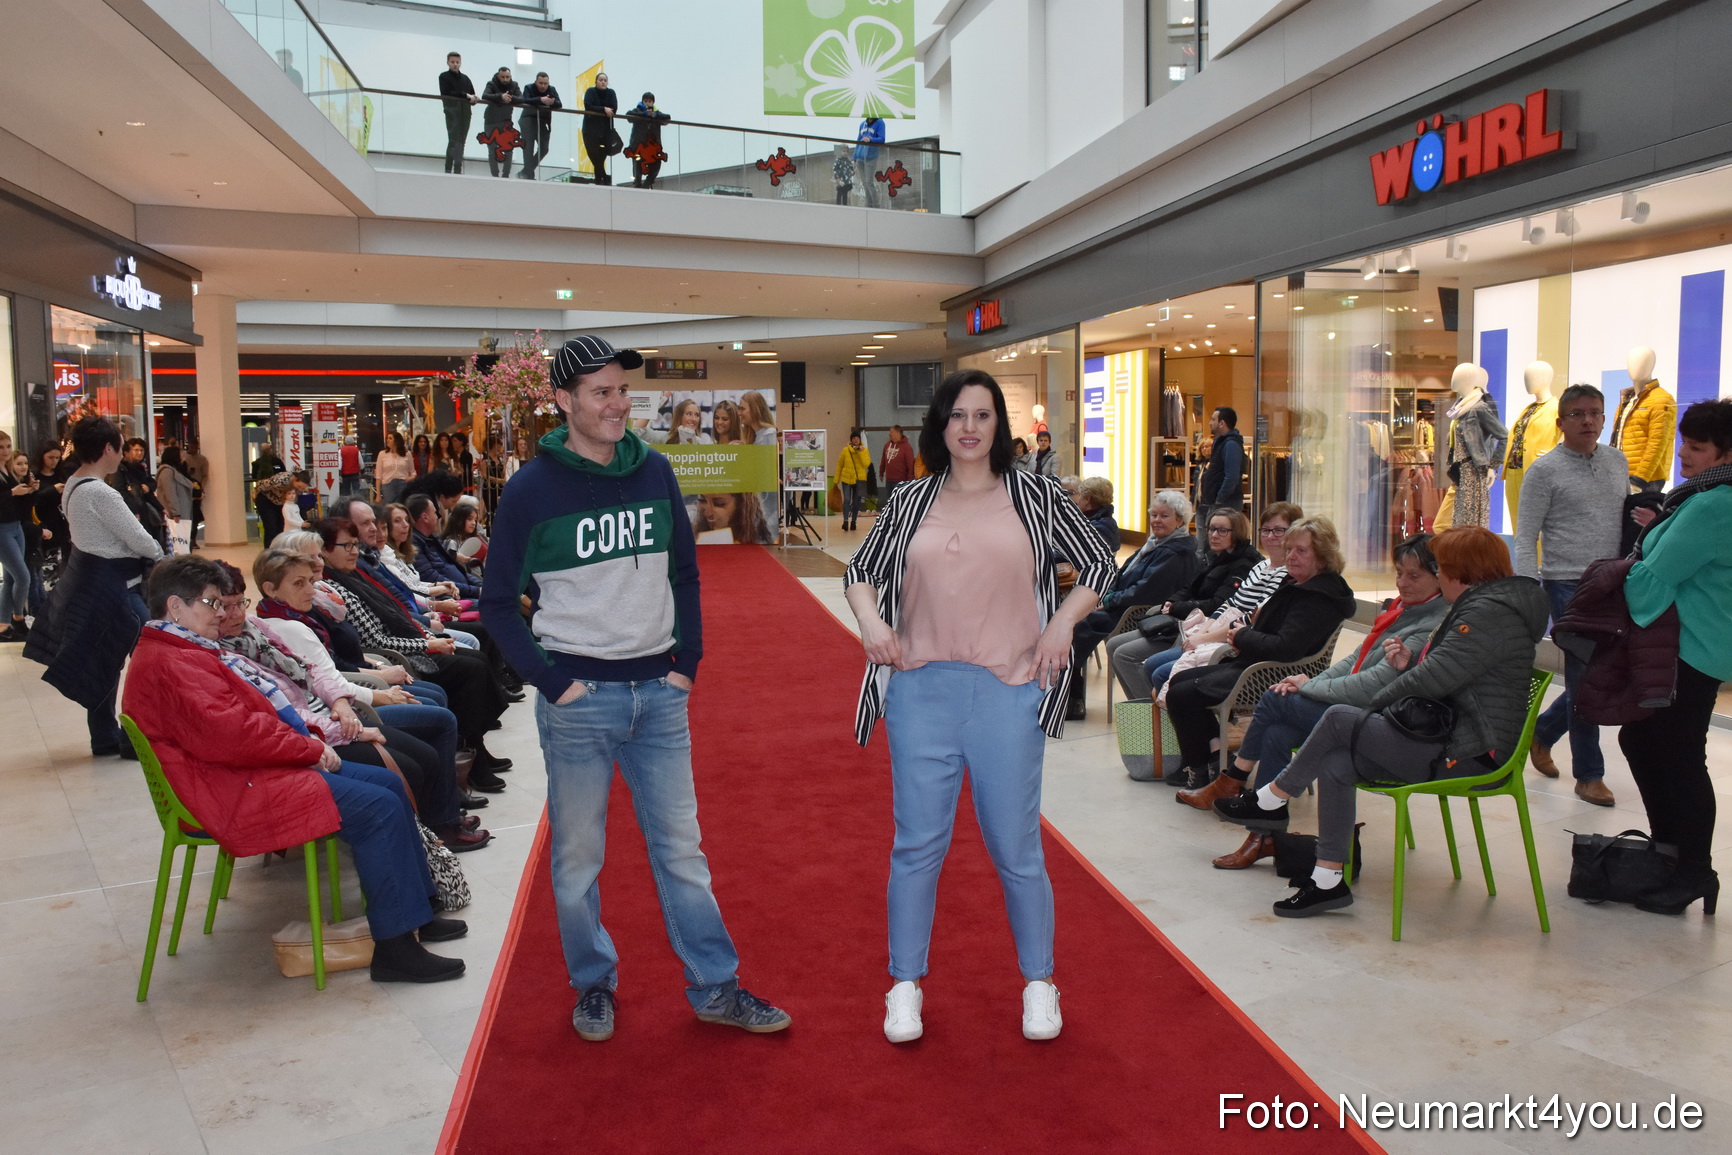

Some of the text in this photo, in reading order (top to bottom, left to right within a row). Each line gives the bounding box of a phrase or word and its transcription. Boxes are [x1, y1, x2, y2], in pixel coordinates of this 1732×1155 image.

[1369, 88, 1562, 206] WÖHRL
[966, 299, 1002, 336] WÖHRL
[55, 369, 80, 390] vis
[290, 427, 301, 467] Markt
[323, 430, 335, 439] dm
[661, 452, 738, 465] hoppingtour
[673, 465, 726, 477] eben pur.
[576, 507, 654, 559] CORE
